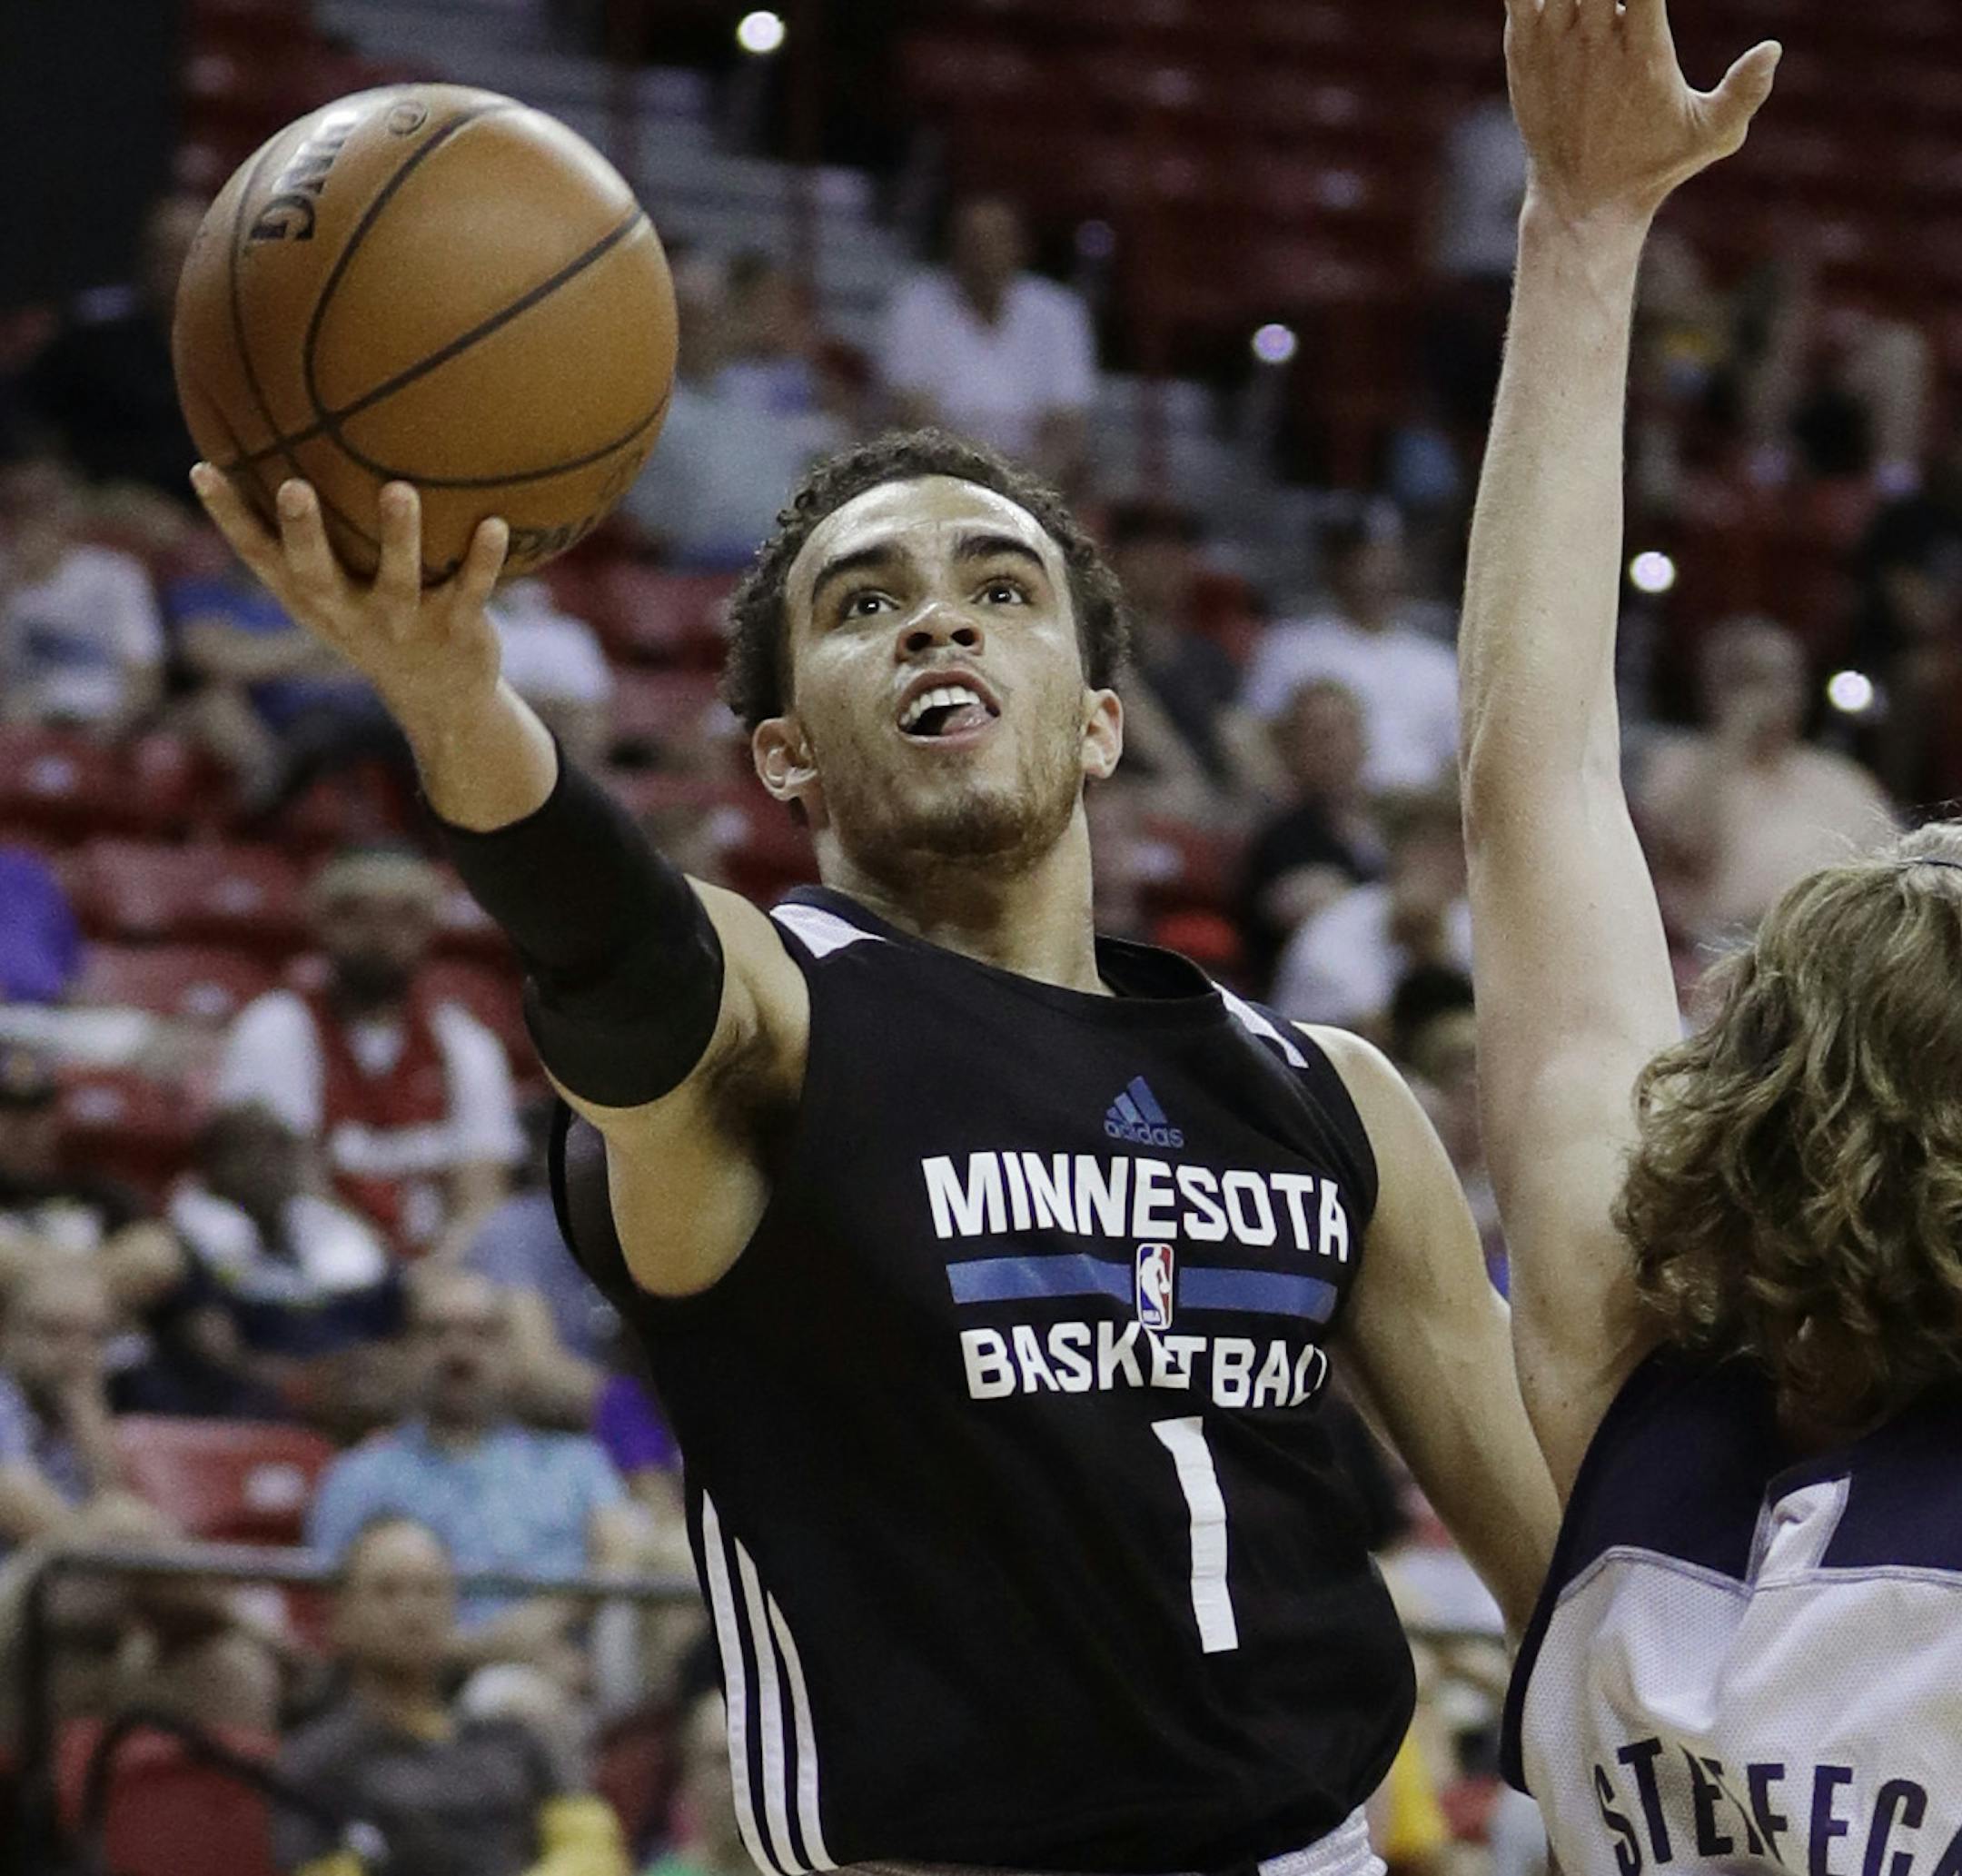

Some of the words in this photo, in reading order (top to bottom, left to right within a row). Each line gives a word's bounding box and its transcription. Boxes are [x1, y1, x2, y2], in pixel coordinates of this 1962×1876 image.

[921, 1151, 1349, 1263] MINNESOTA
[959, 1321, 1328, 1408] BASKETBAL
[1150, 1415, 1239, 1654] 1
